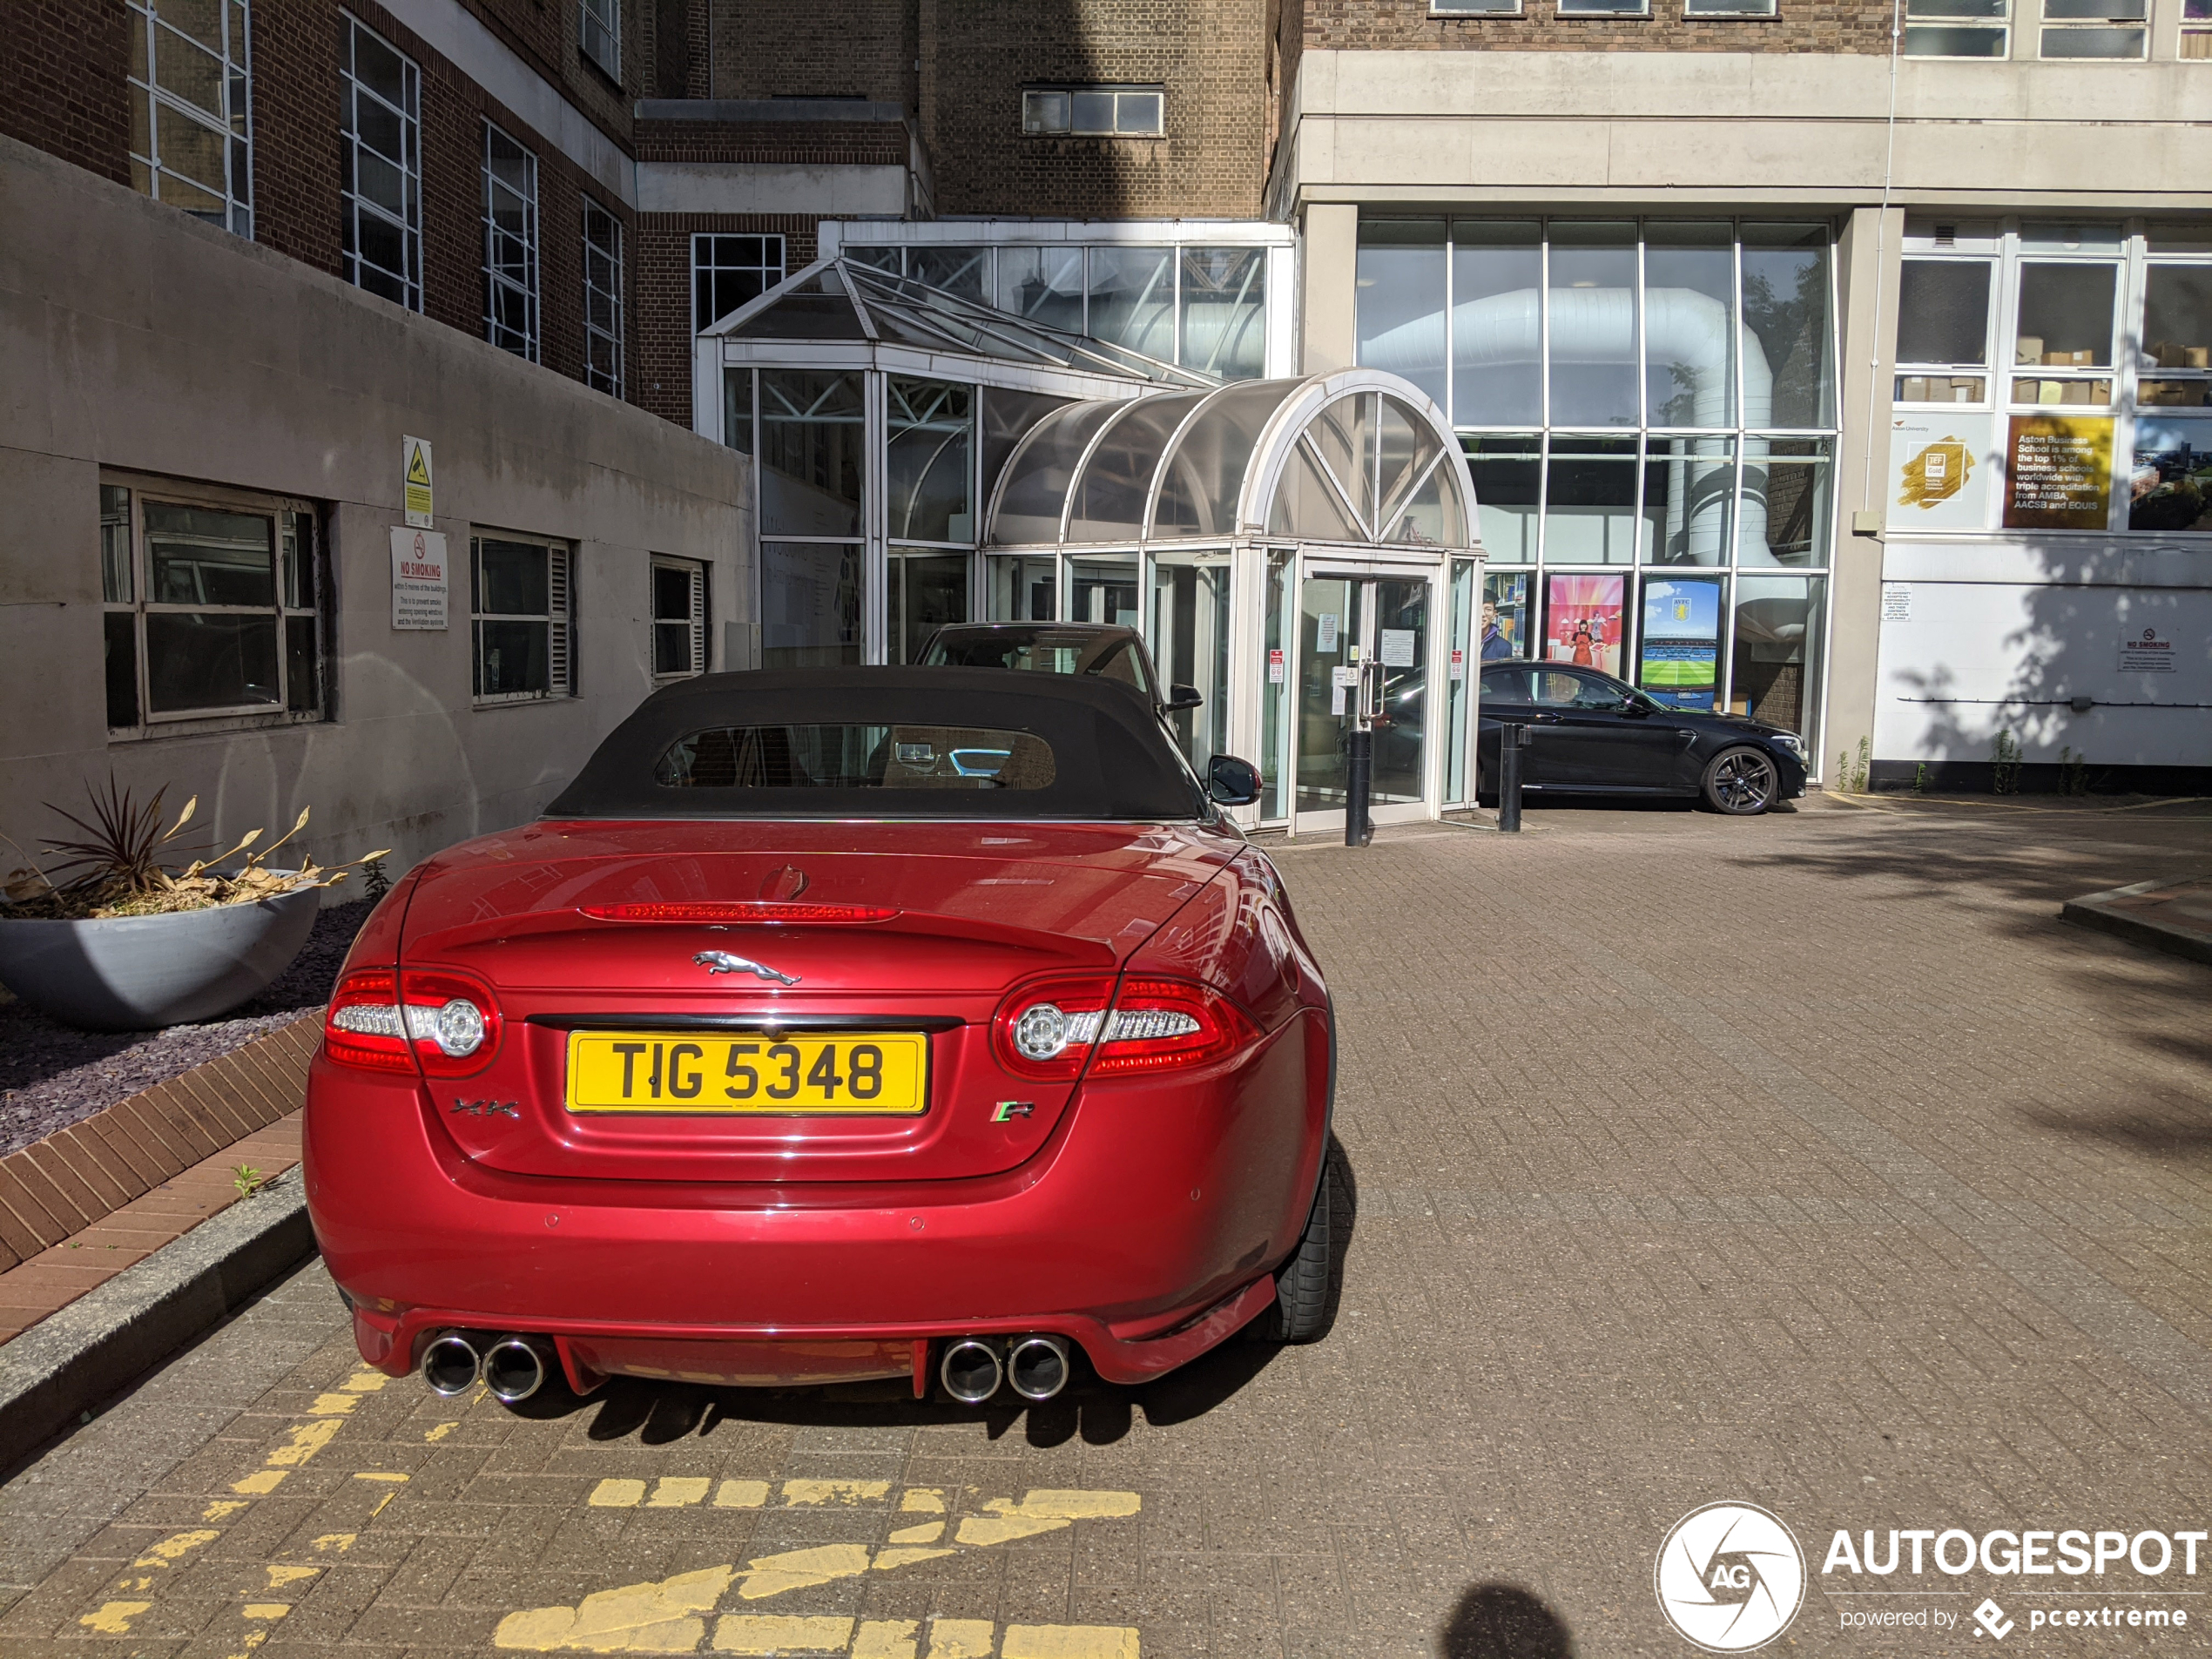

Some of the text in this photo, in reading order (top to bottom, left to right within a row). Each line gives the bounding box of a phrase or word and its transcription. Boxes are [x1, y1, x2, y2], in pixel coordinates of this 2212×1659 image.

[2018, 435, 2088, 444] Aston Business
[2035, 455, 2049, 463] top
[2016, 482, 2039, 491] triple
[2038, 492, 2069, 501] AMBA,
[401, 561, 440, 577] NO SMOKING
[613, 1043, 883, 1099] TIG 5348
[449, 1098, 519, 1117] XK
